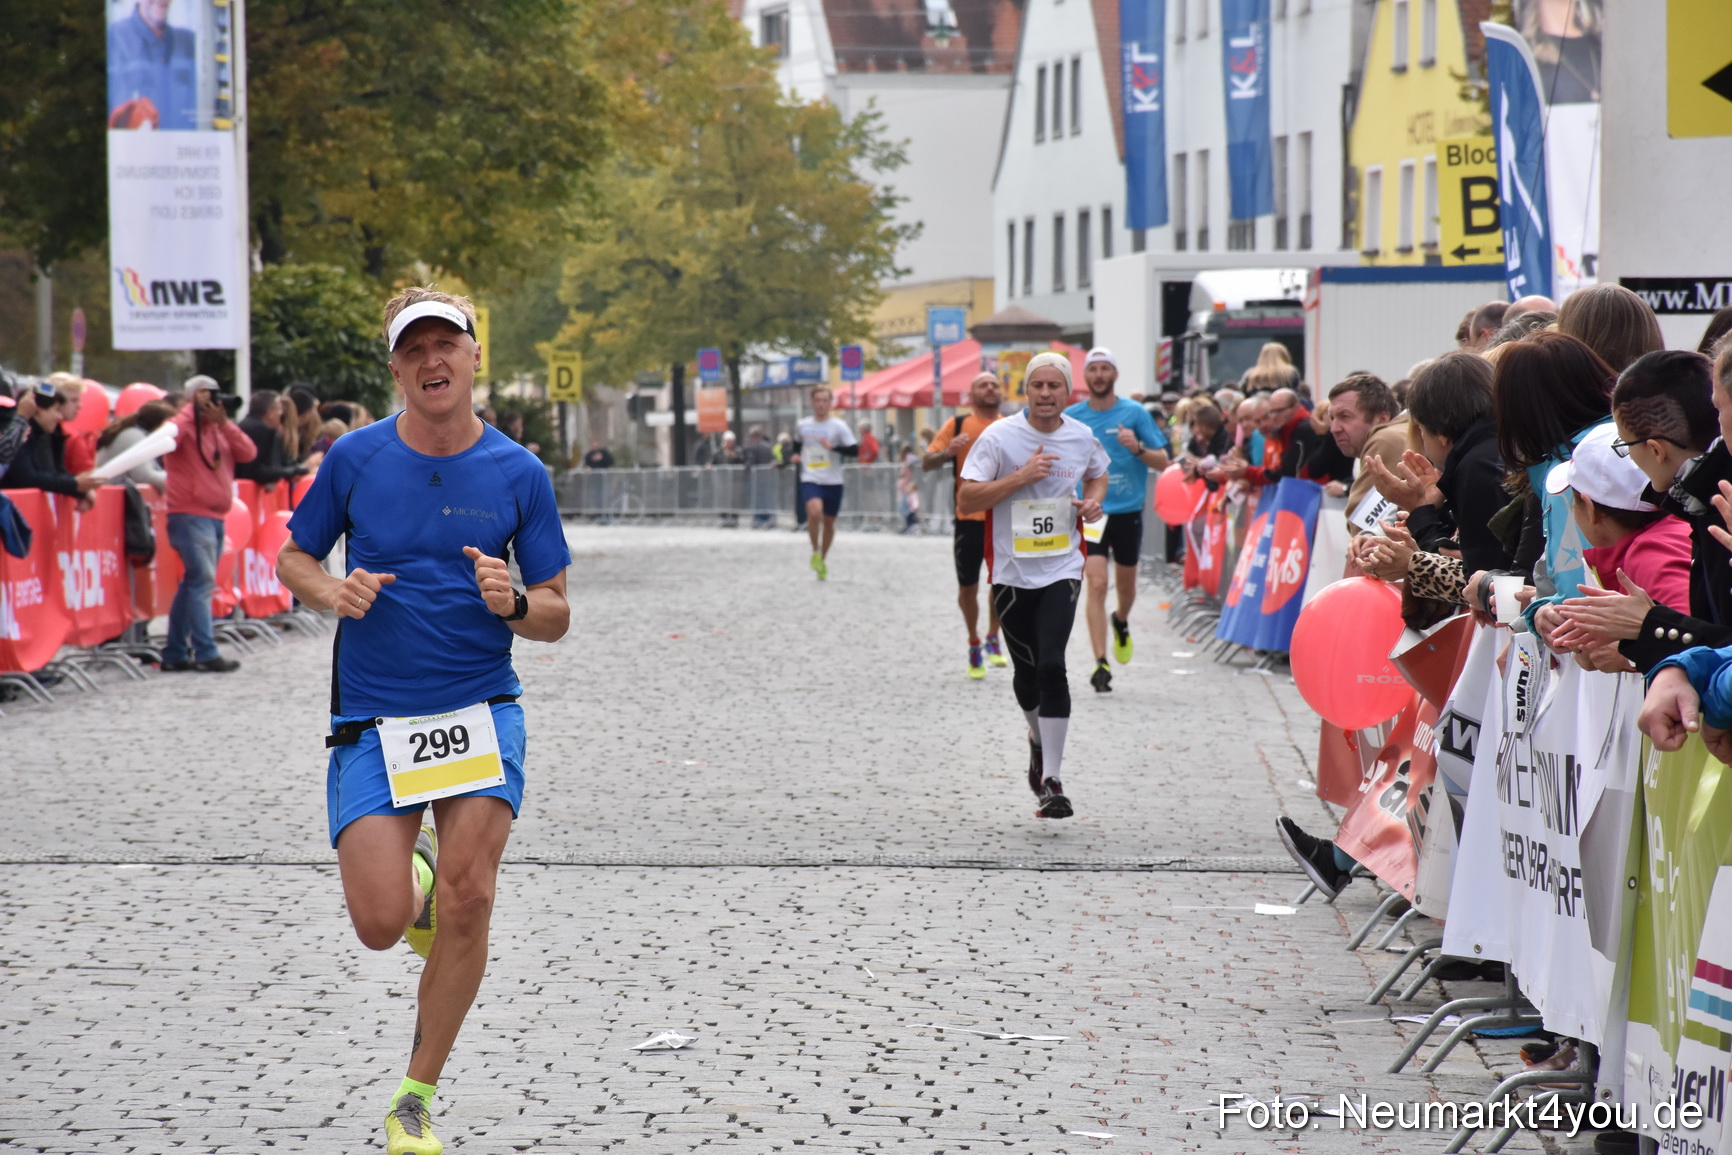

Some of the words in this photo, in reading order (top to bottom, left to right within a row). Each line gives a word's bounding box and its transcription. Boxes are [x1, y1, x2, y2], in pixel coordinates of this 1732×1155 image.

[1447, 144, 1497, 167] Bloc
[1461, 176, 1501, 236] B
[557, 366, 573, 389] D
[453, 508, 498, 520] MICRONAS
[1032, 517, 1054, 534] 56
[1516, 670, 1529, 722] swn
[408, 724, 470, 764] 299
